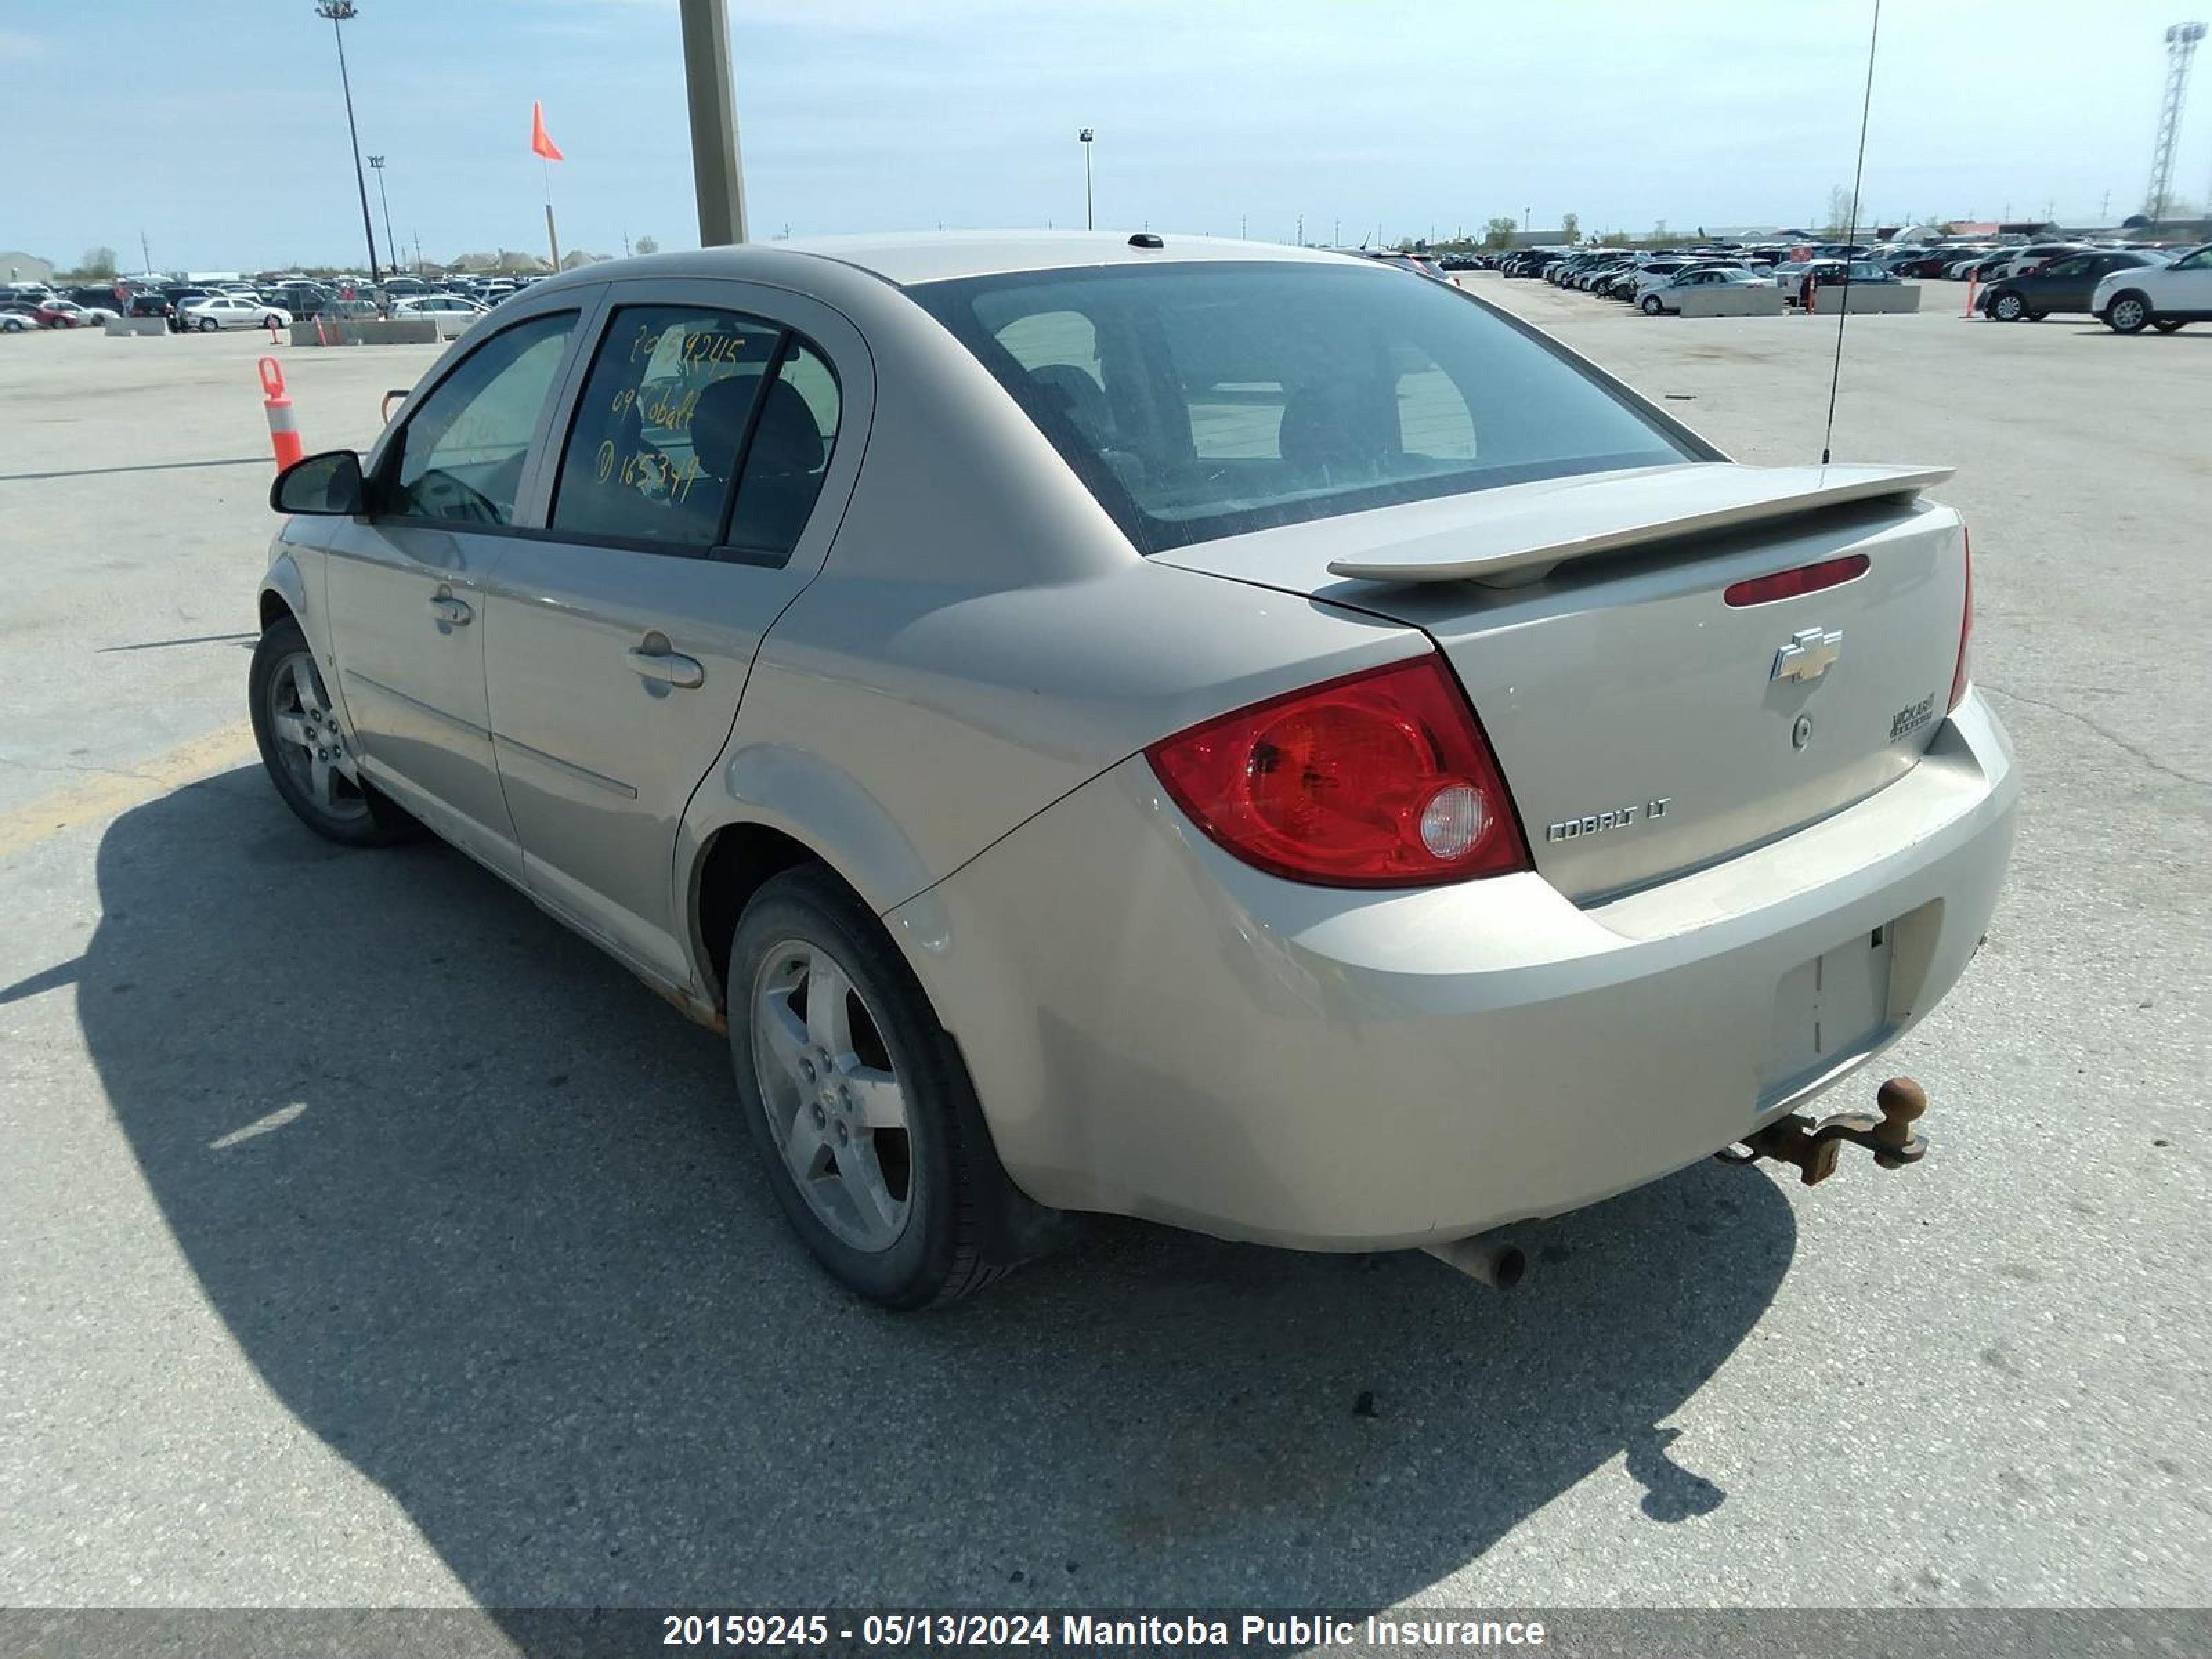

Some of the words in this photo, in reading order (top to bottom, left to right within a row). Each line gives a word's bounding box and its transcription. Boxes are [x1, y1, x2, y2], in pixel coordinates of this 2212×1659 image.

[612, 389, 635, 422] 09
[1547, 806, 1638, 842] COBALT
[1647, 797, 1671, 819] LT
